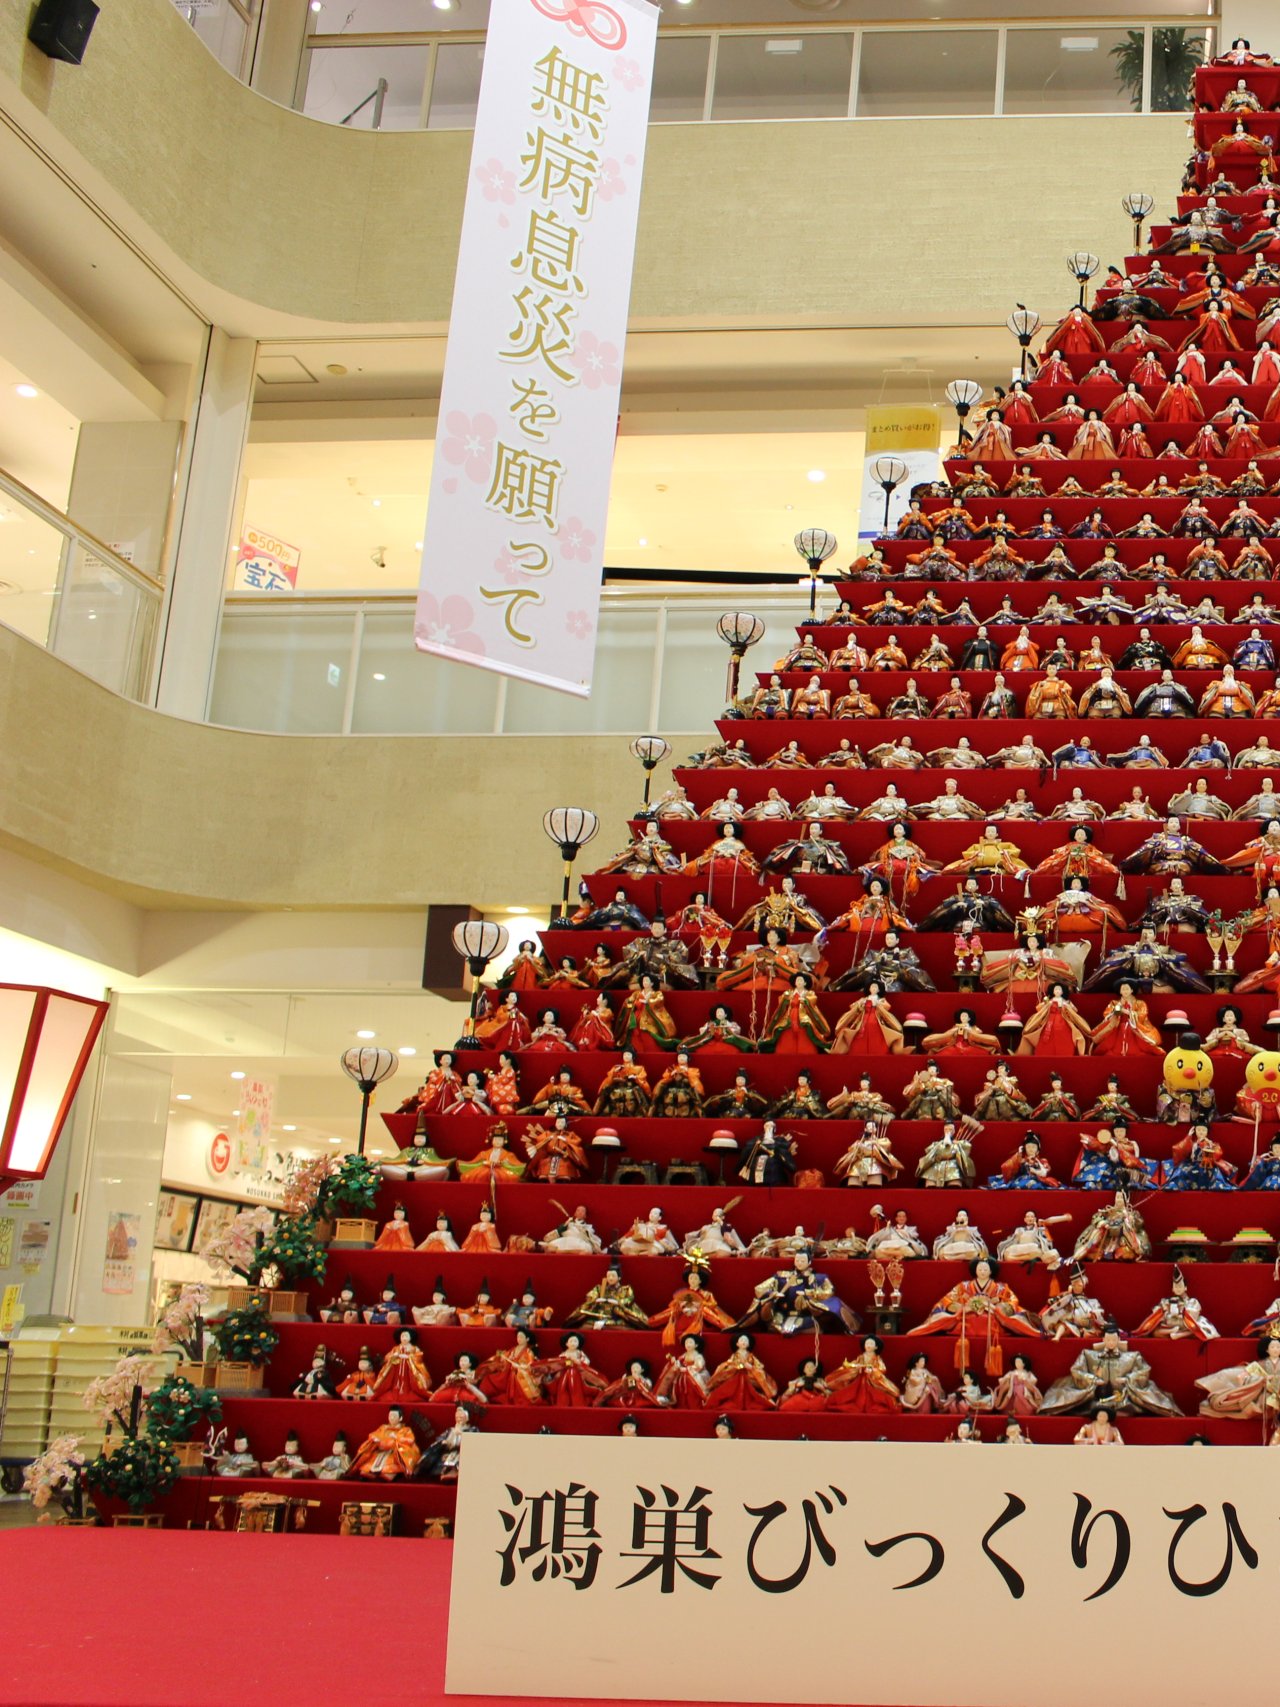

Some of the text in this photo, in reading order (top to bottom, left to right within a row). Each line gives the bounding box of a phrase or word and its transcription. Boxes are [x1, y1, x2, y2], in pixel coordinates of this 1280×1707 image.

[480, 45, 608, 644] 無病息災を願って
